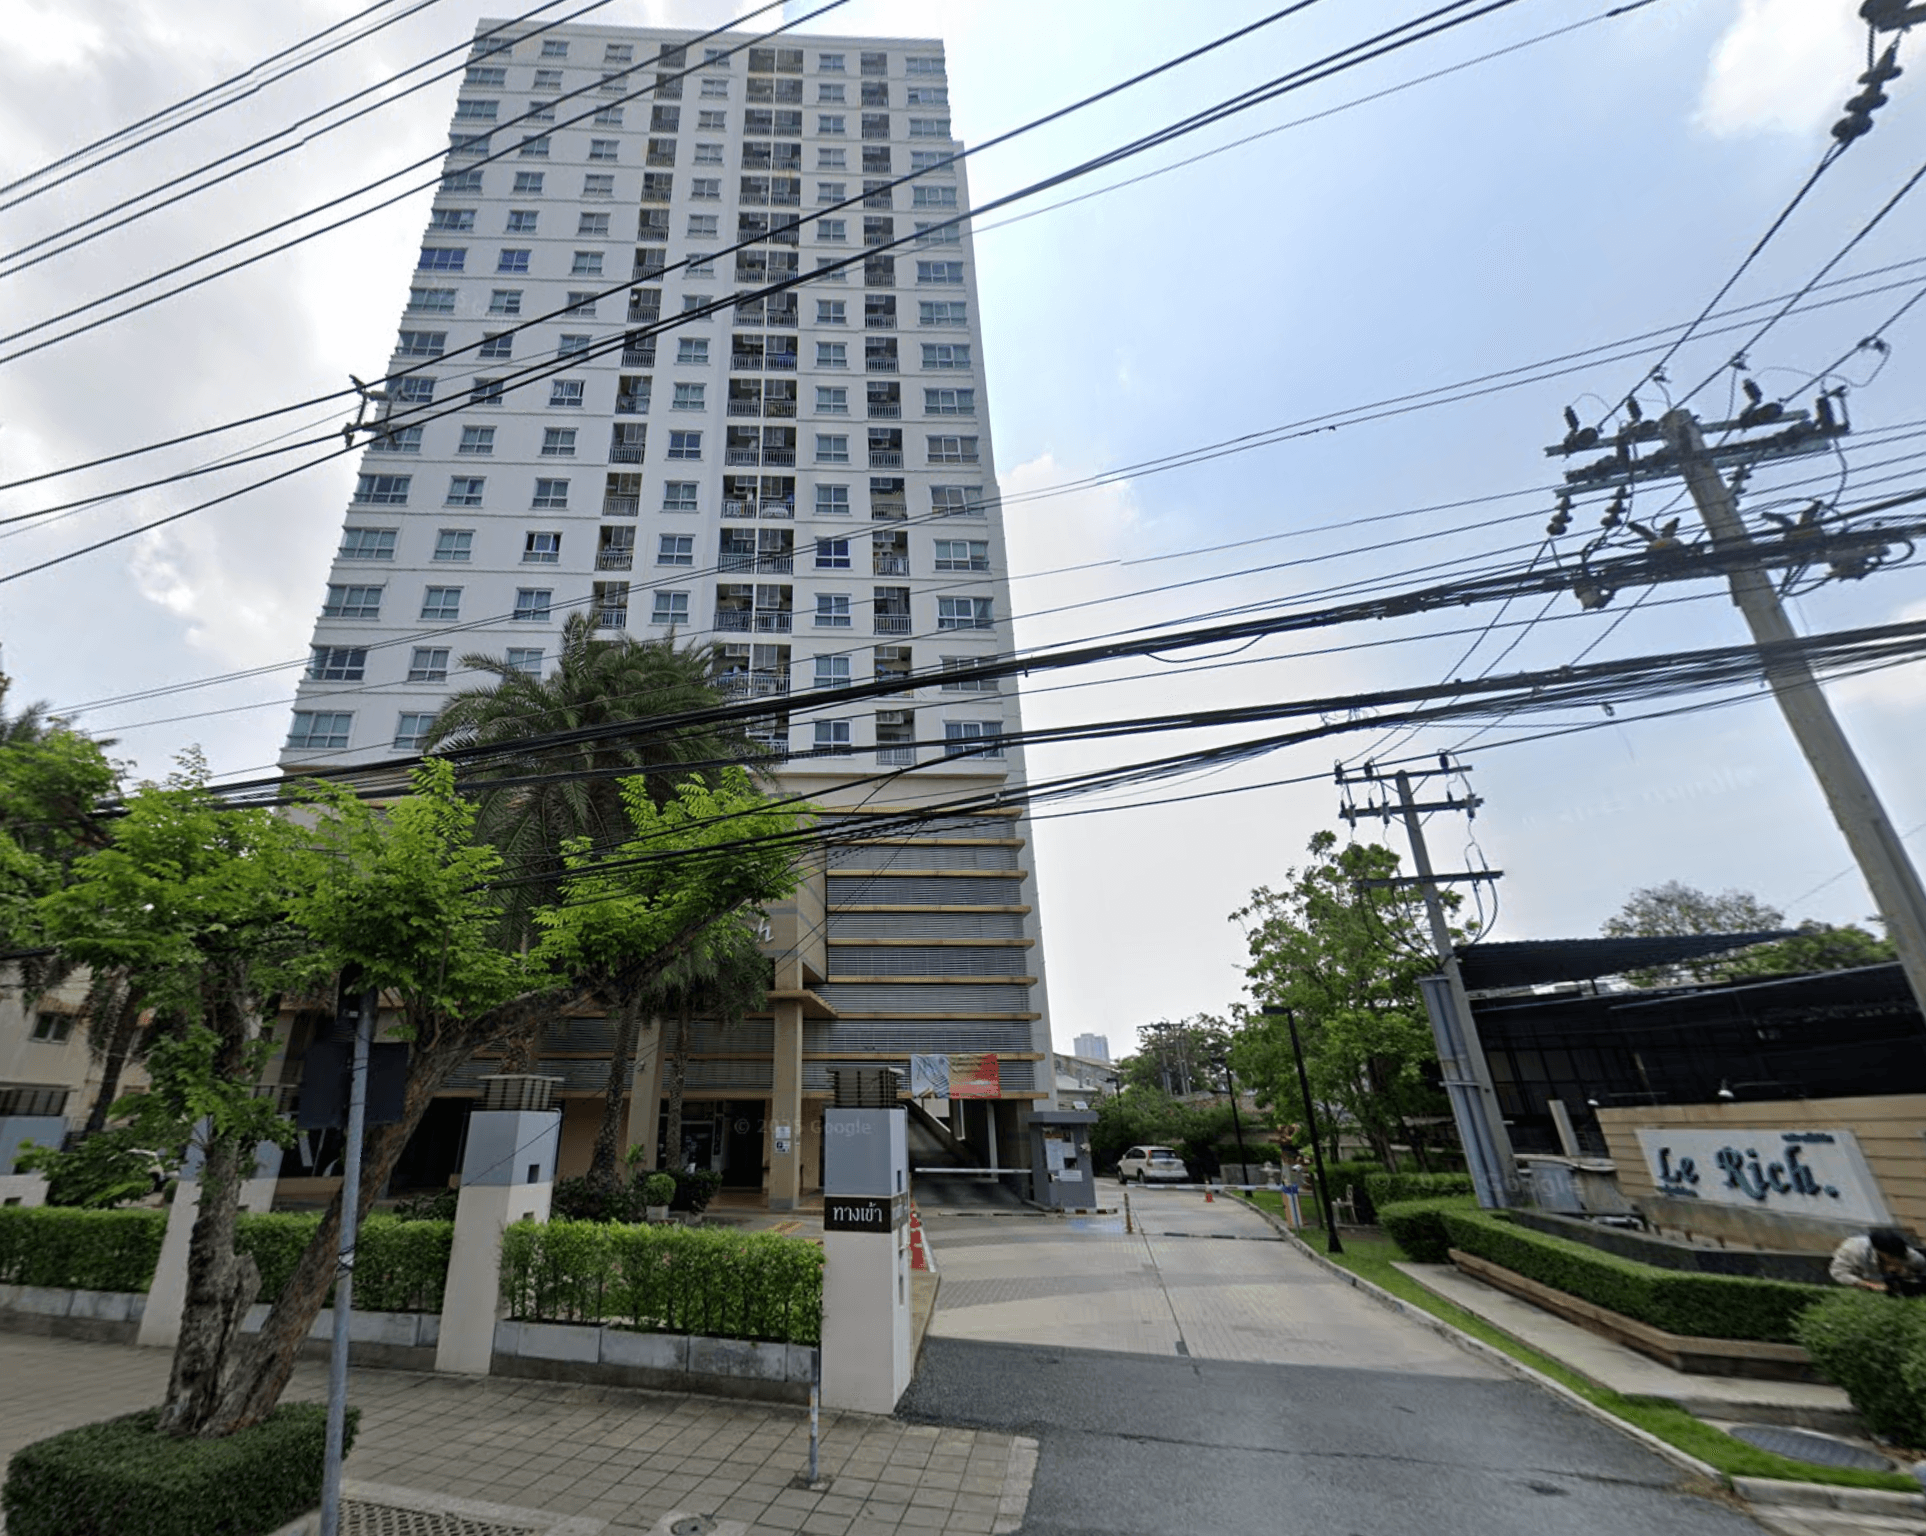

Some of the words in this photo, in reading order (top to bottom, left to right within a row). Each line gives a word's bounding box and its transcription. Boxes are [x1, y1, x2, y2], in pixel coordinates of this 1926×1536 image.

[1659, 1147, 1699, 1184] Le
[832, 1202, 882, 1222] ทางเข้า
